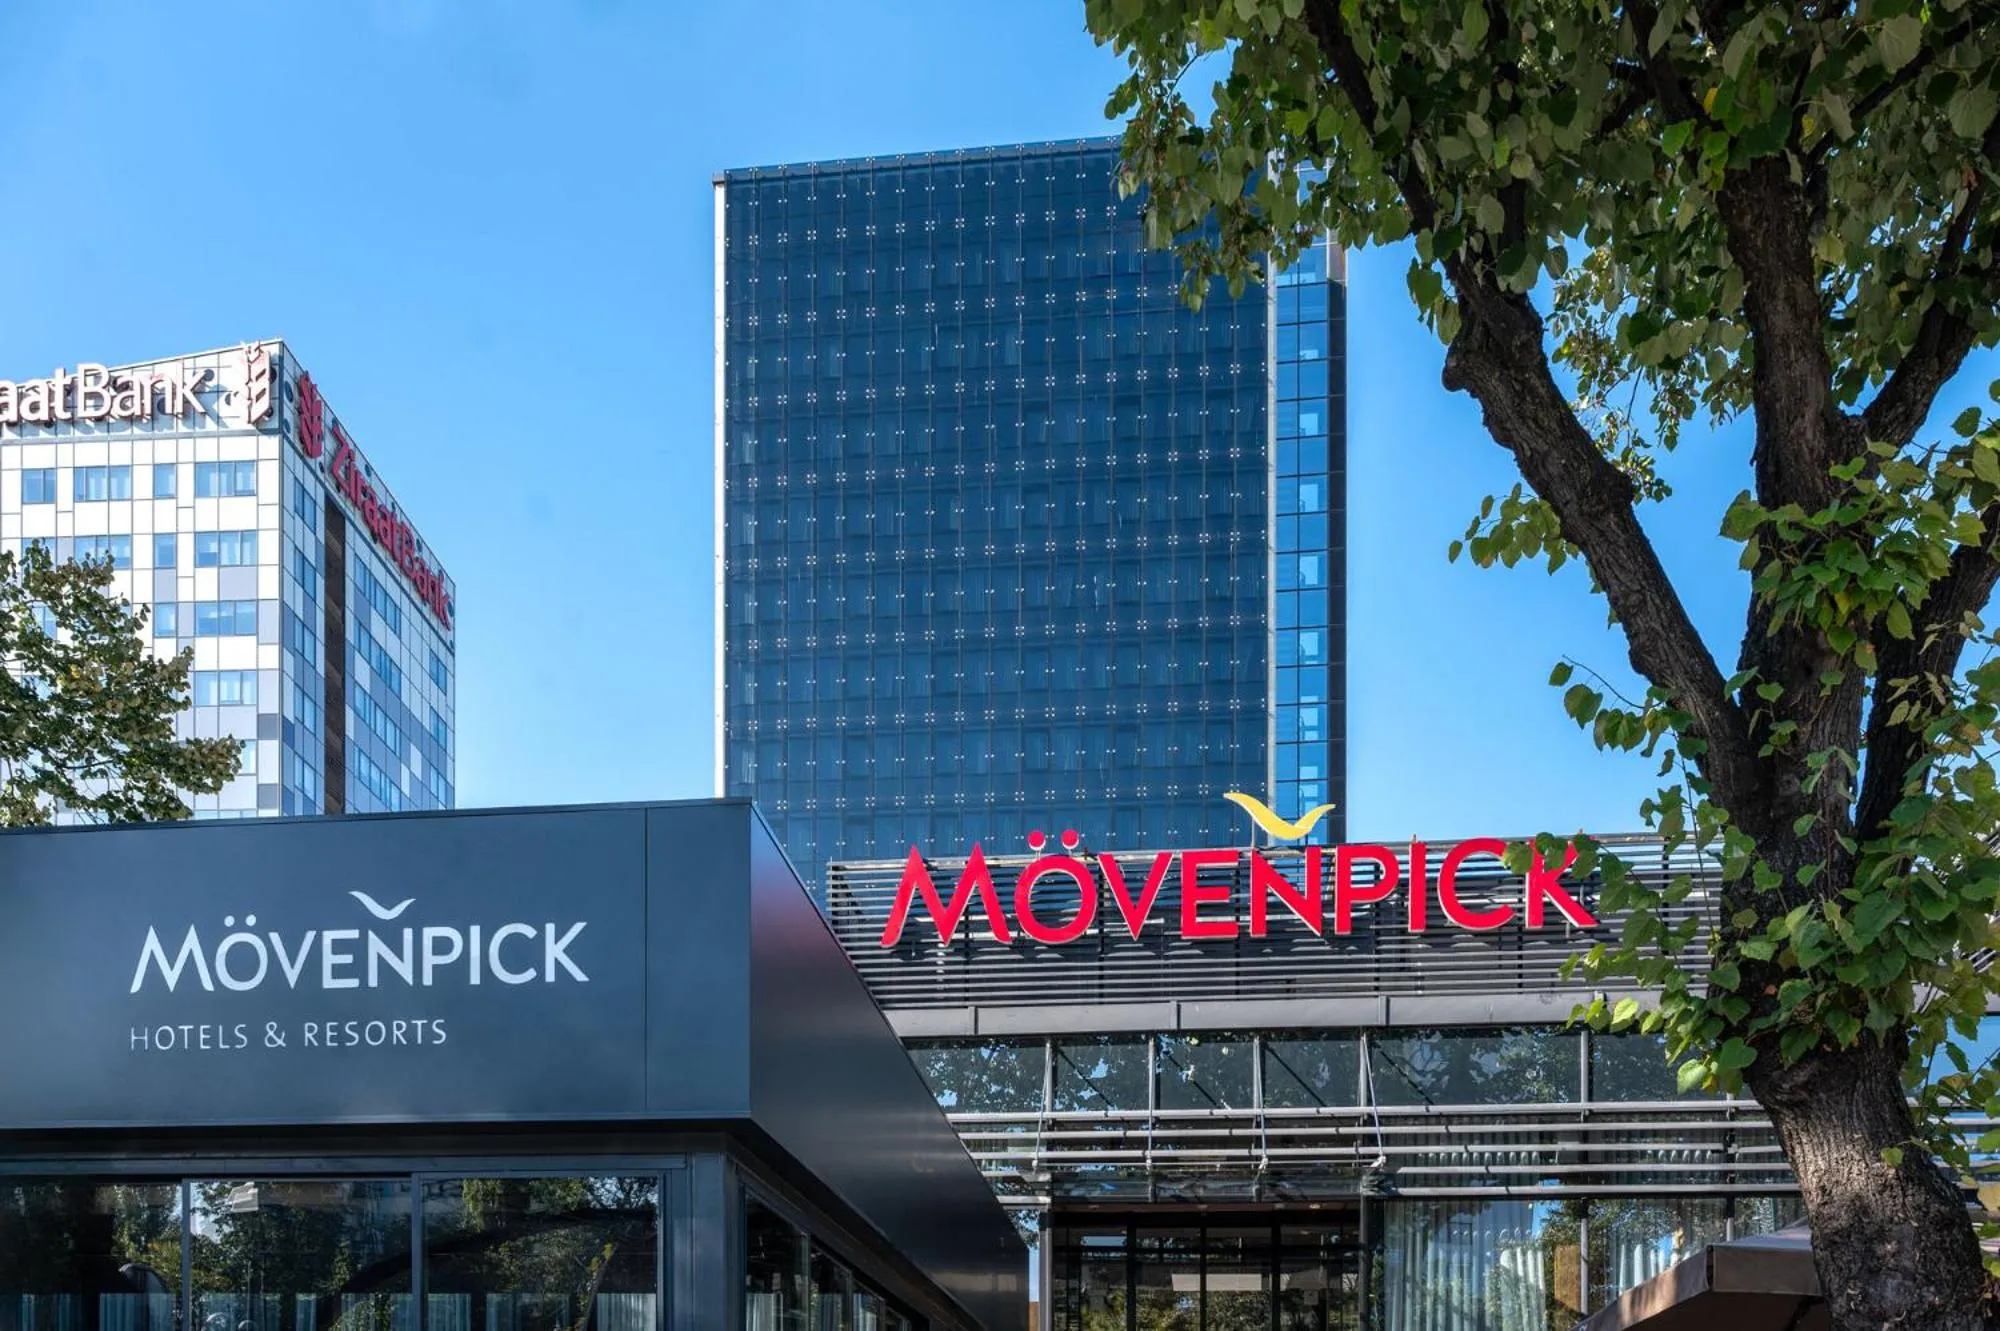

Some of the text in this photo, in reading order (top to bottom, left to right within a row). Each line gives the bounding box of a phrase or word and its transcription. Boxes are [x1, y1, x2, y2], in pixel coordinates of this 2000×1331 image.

[881, 830, 1599, 946] MÖVENPICK
[130, 914, 590, 994] MÖVENPICK
[130, 1019, 447, 1051] HOTELS & RESORTS
